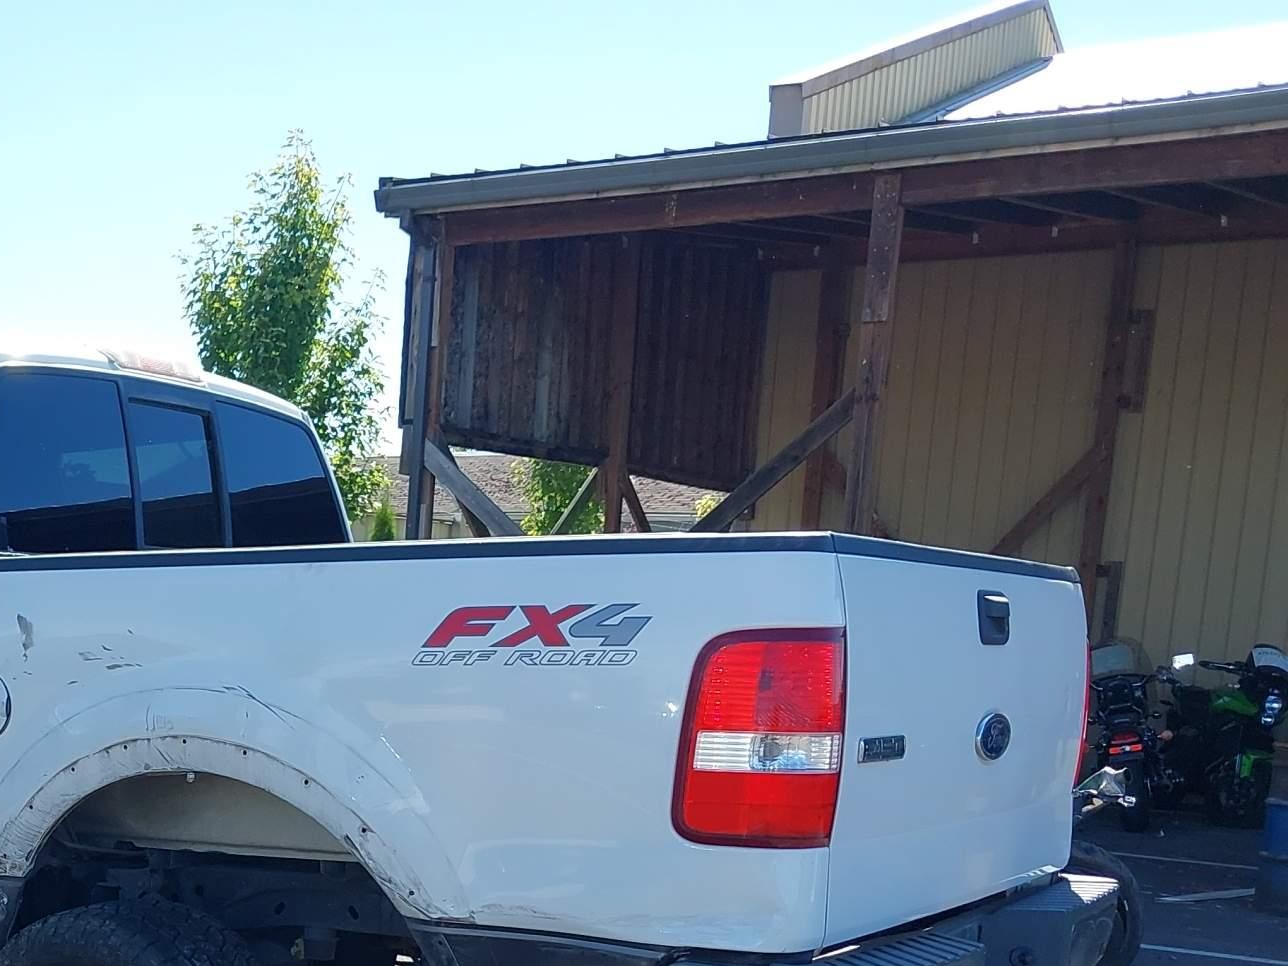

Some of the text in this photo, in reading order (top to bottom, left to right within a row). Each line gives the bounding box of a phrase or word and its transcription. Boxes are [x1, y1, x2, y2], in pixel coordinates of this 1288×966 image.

[420, 603, 653, 648] FX4
[411, 650, 638, 666] OFF ROAD
